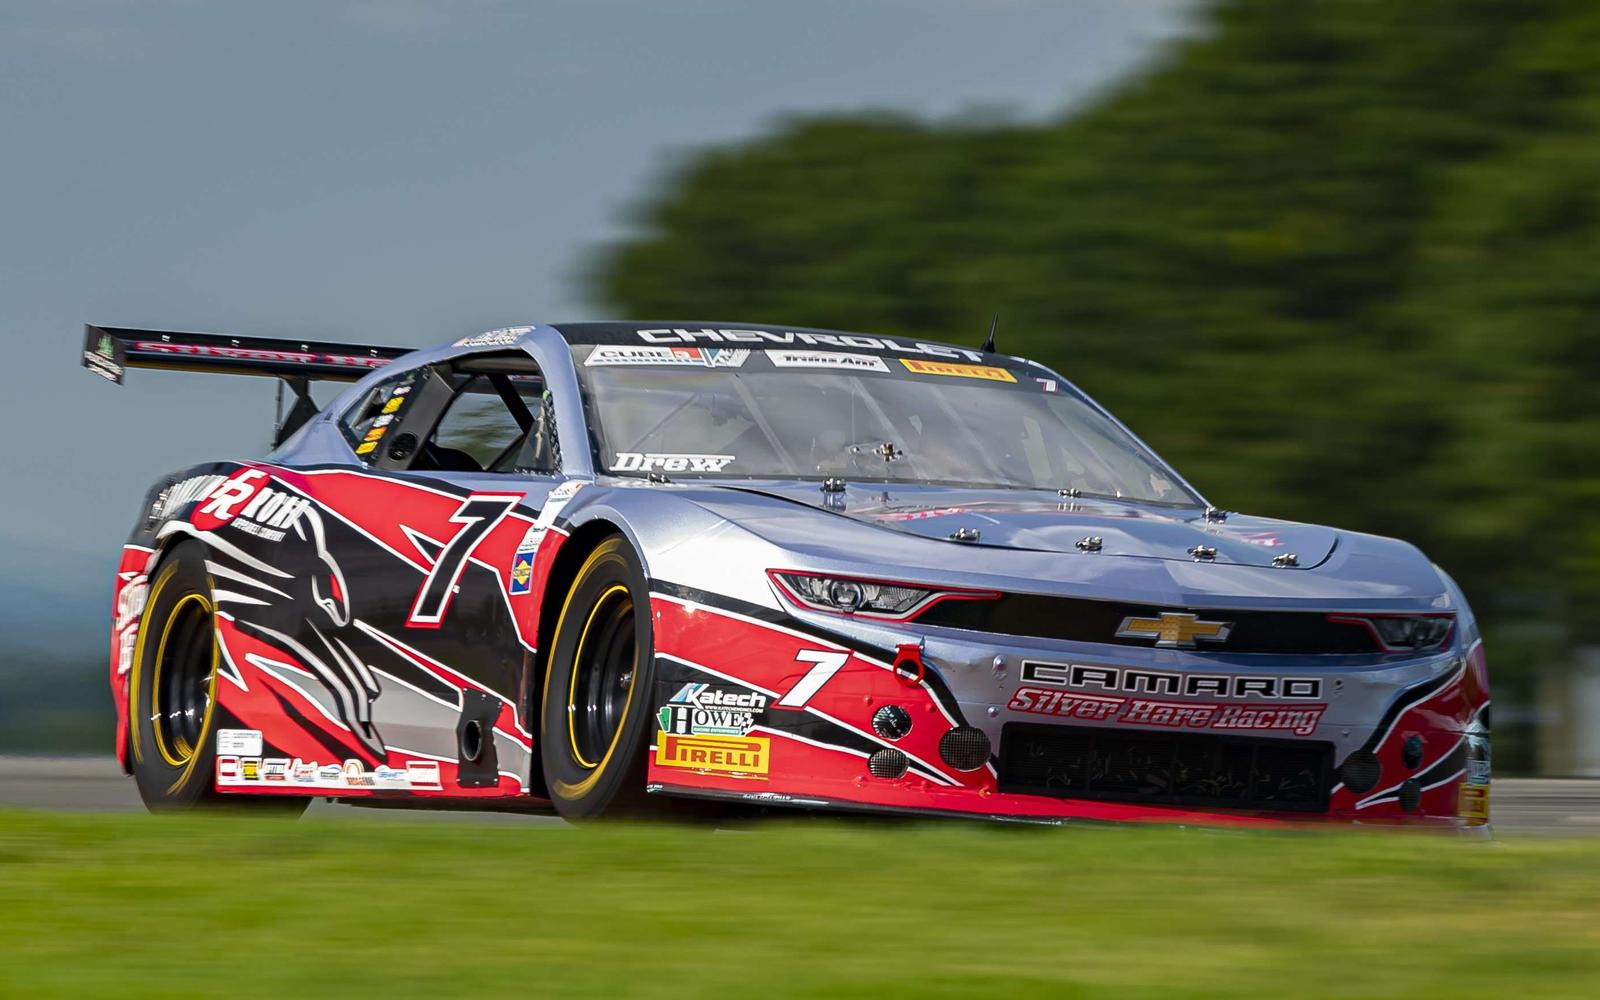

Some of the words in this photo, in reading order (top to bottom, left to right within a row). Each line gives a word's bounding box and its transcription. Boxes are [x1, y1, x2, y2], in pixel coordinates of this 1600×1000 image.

[636, 327, 984, 363] CHEVROLET
[907, 360, 1007, 379] PIRELLI
[608, 452, 735, 472] Drew
[406, 492, 524, 626] 7
[669, 682, 767, 710] Katech
[771, 648, 850, 710] 7
[1020, 659, 1324, 699] CAMARO
[666, 704, 742, 735] HOWE
[1010, 687, 1127, 721] Silver
[1118, 700, 1218, 728] Hare
[1212, 704, 1326, 735] Racing
[665, 736, 762, 768] PIRELLI
